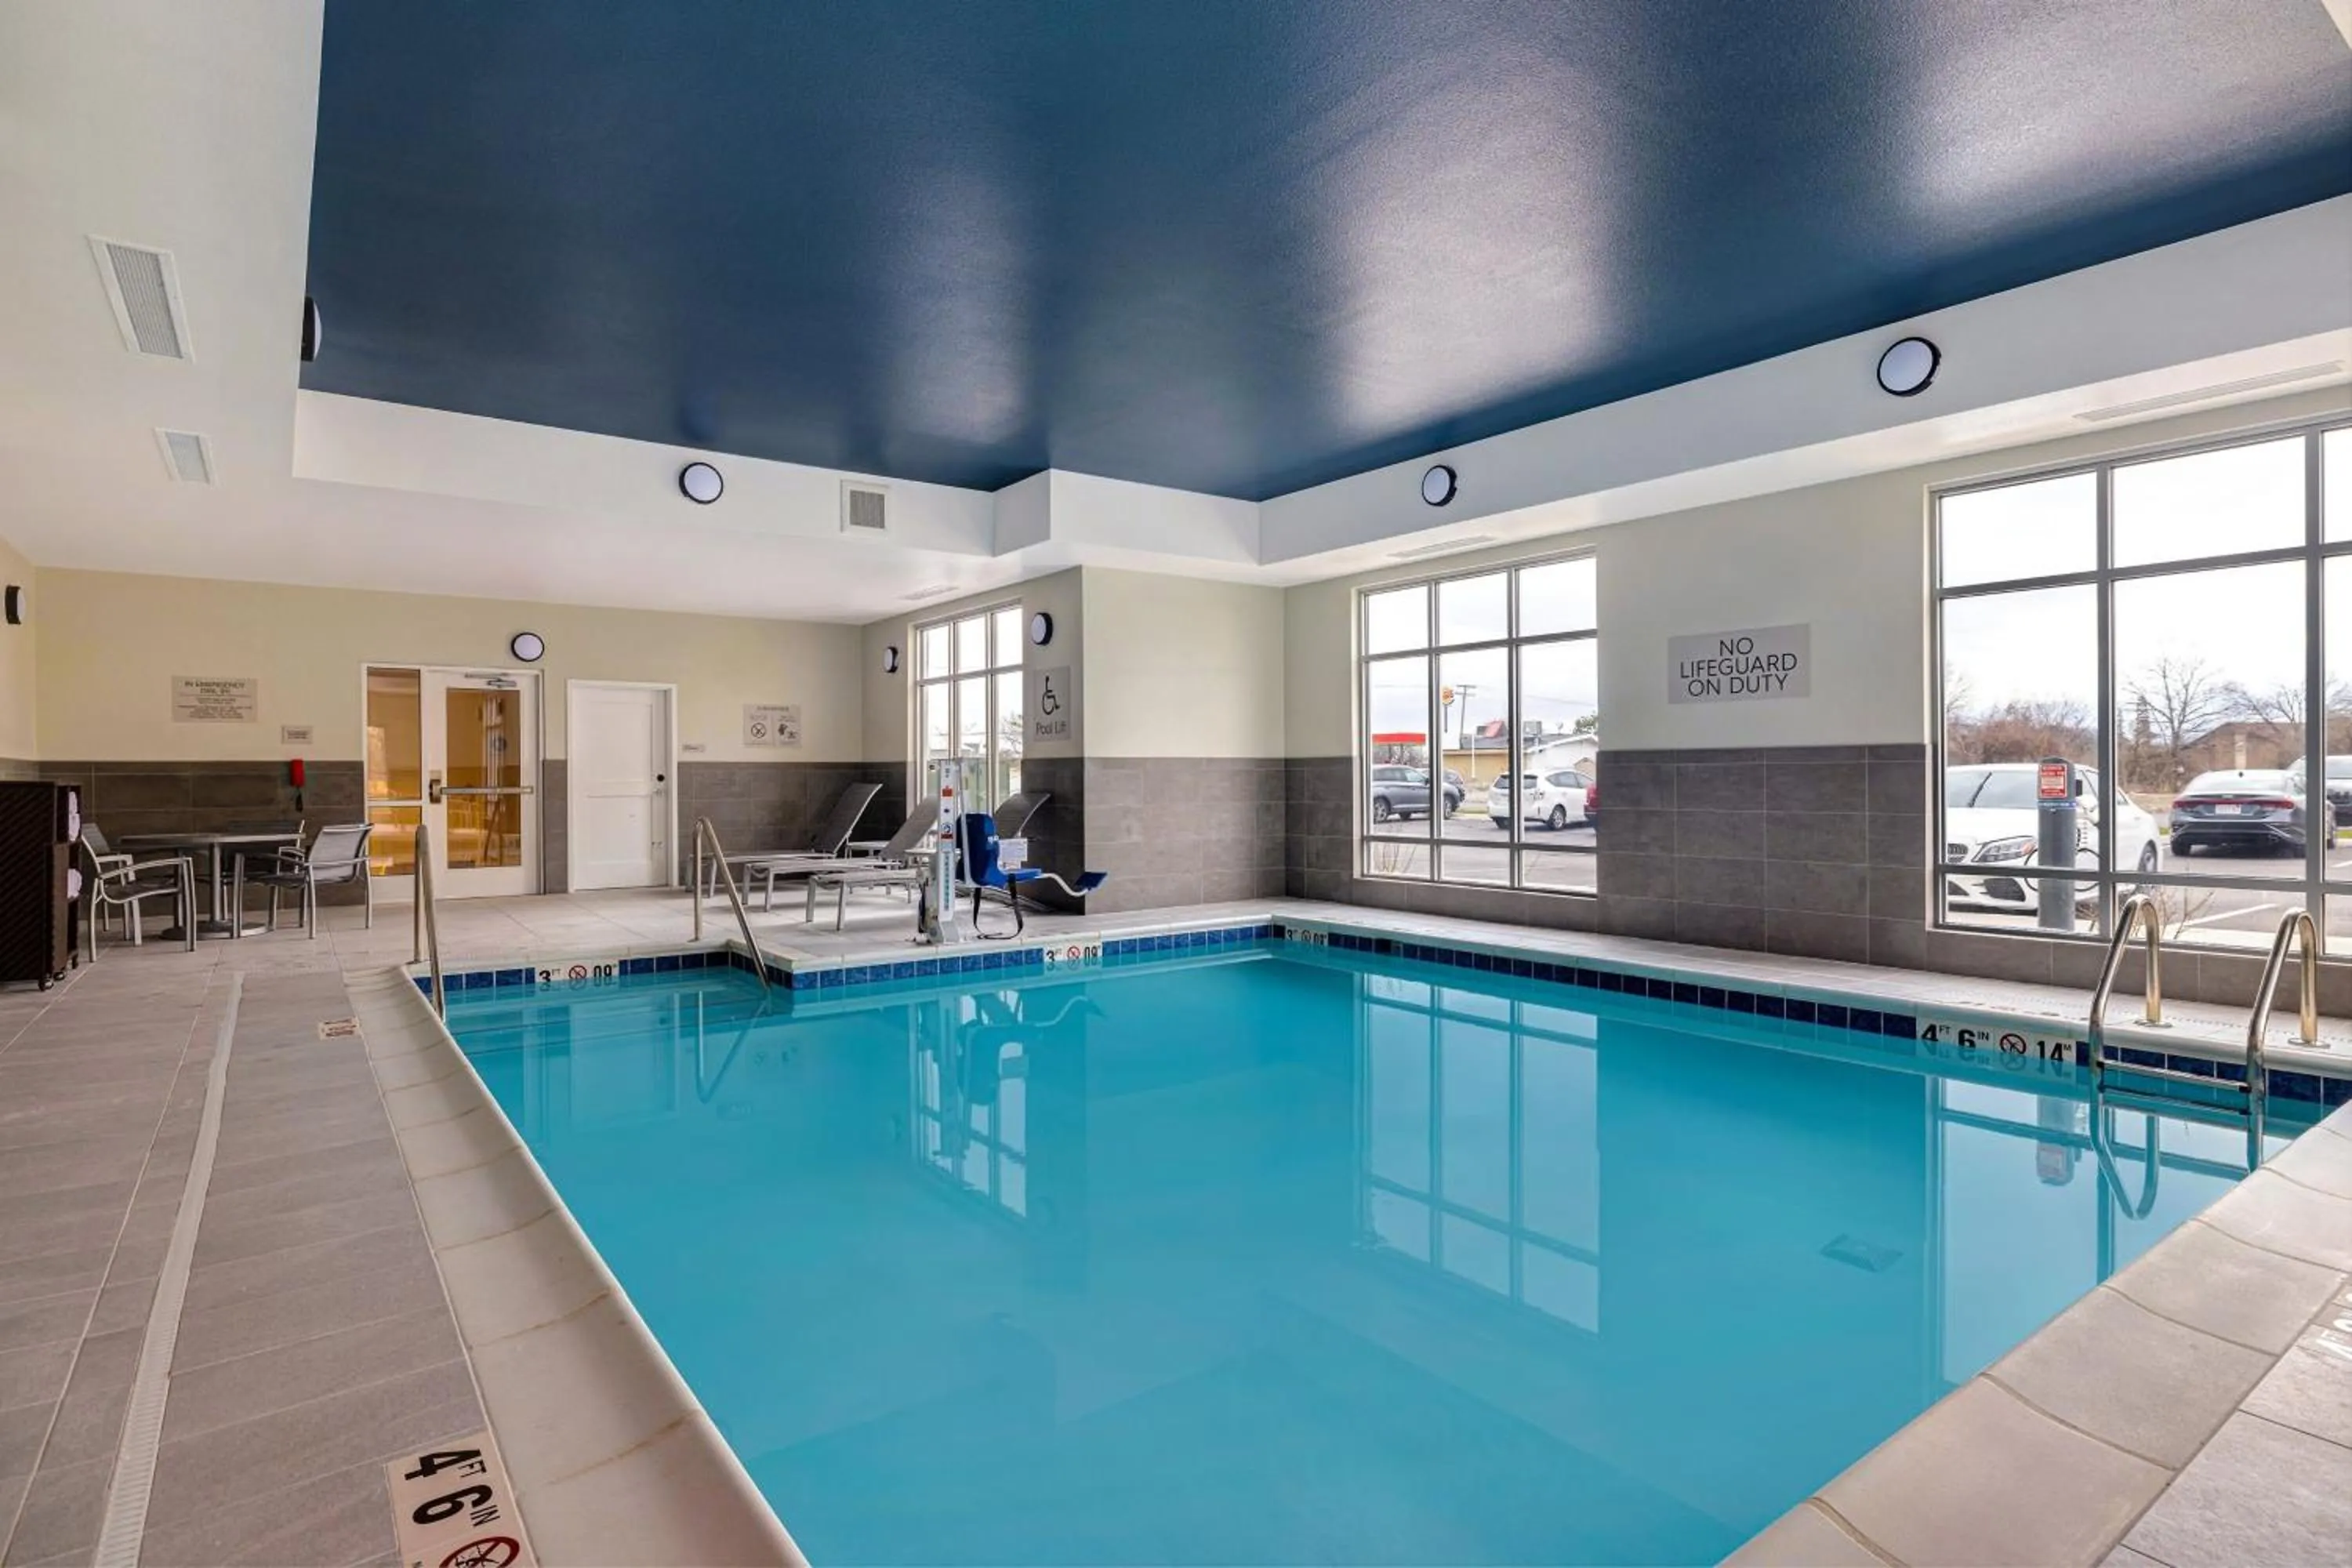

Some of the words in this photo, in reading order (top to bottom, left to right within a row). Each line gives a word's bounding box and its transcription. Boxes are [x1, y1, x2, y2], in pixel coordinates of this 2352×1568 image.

[1719, 637, 1755, 656] NO
[1680, 653, 1798, 678] LIFEGUARD
[1688, 677, 1721, 696] ON
[1730, 673, 1788, 694] DUTY
[1036, 722, 1053, 735] Pool
